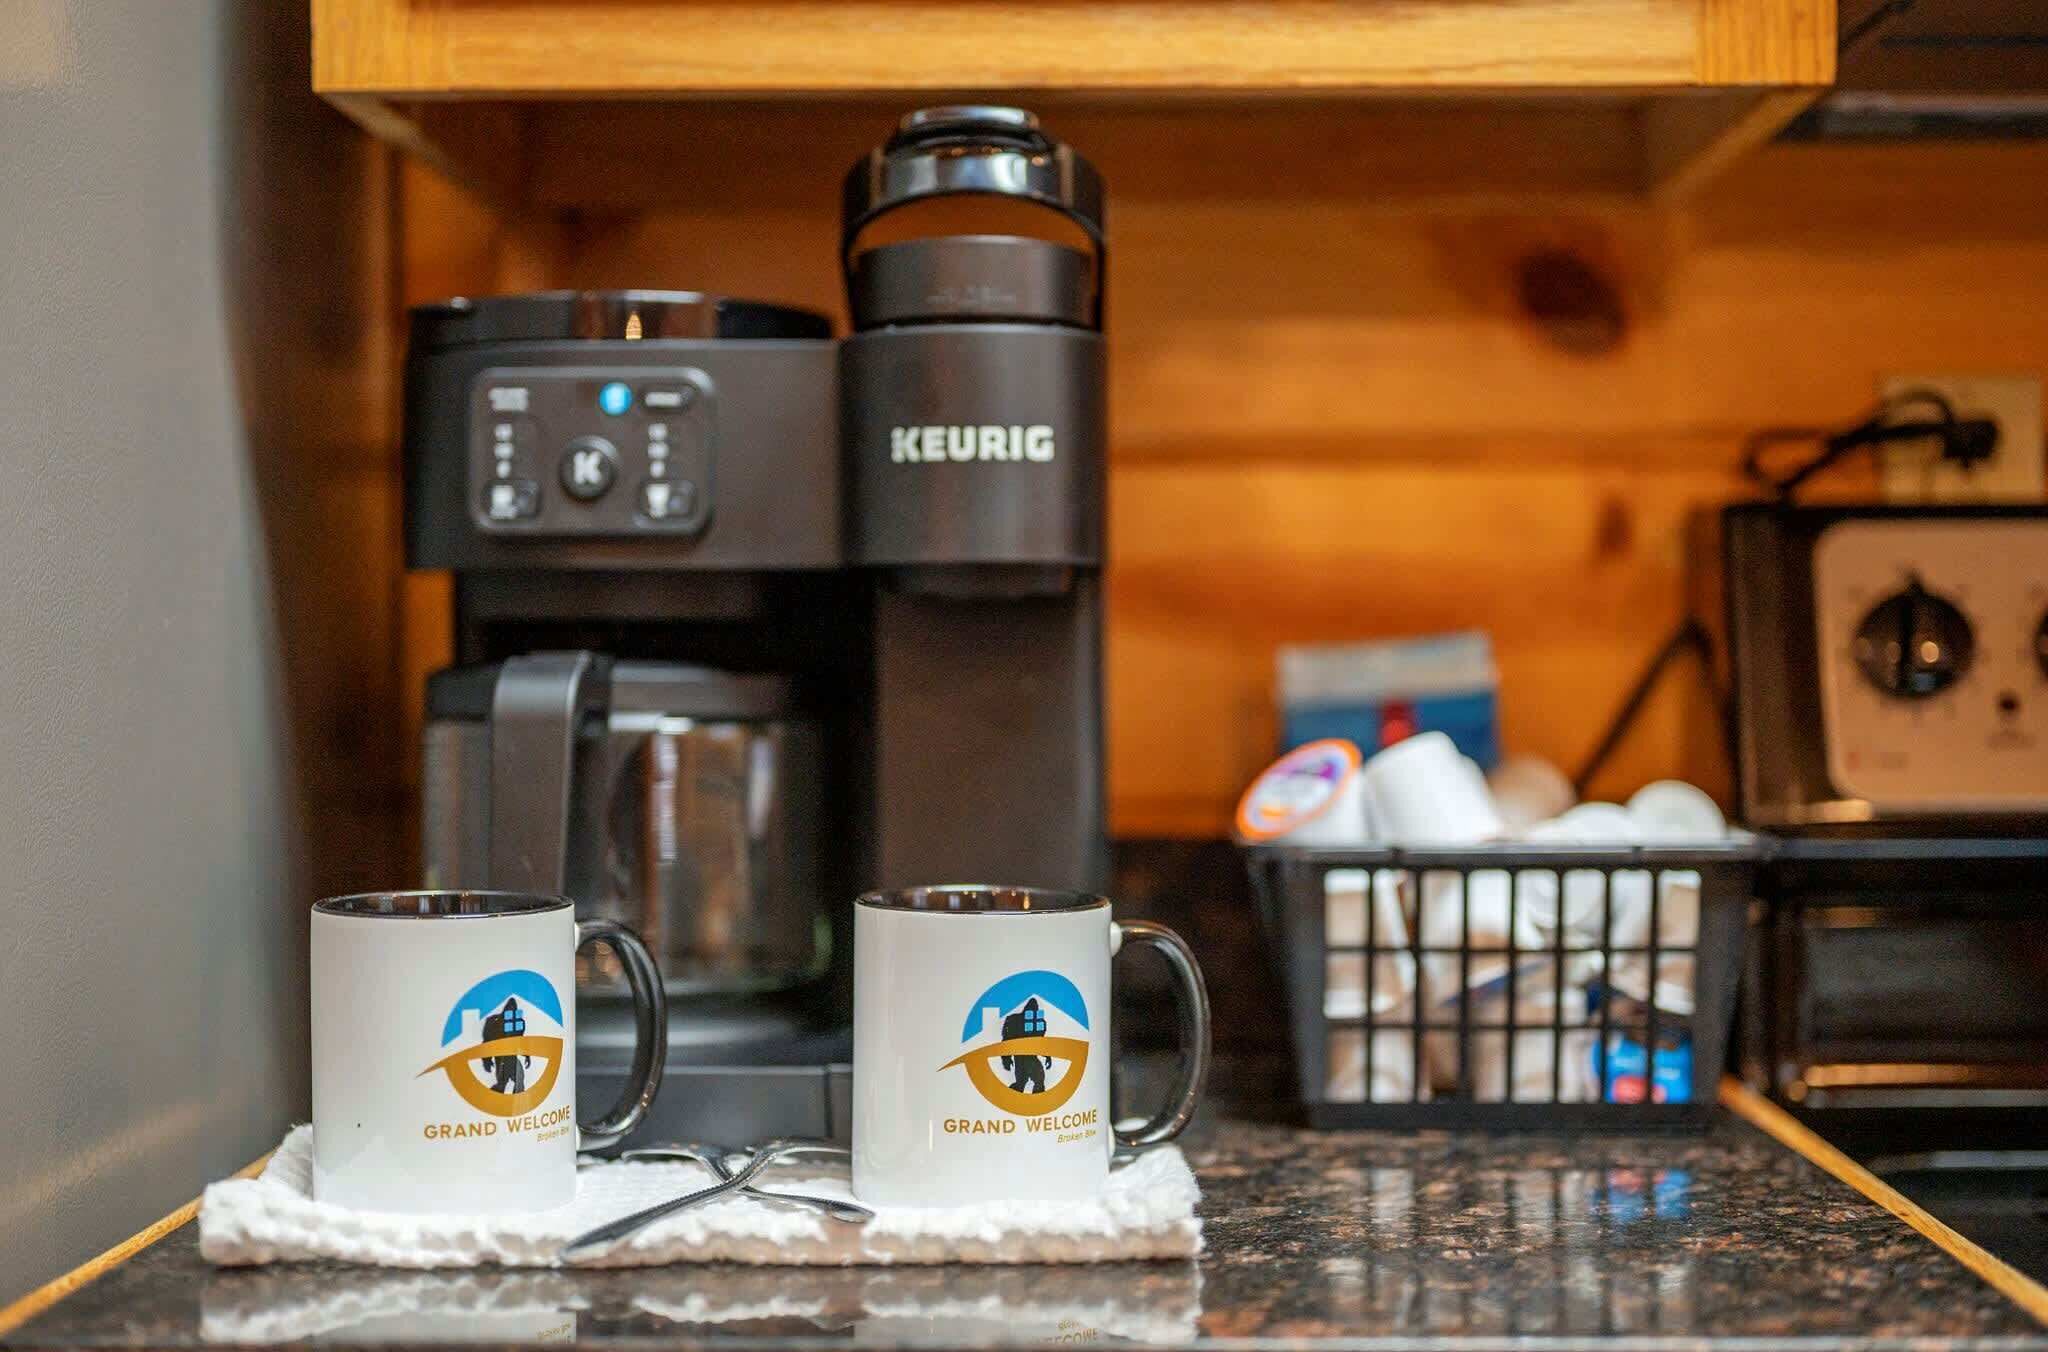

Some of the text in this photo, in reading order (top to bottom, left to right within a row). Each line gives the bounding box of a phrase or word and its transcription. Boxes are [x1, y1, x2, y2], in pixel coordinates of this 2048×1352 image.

[891, 425, 1055, 463] KEURIG
[573, 450, 602, 485] K
[423, 1105, 570, 1140] GRAND WELCOME
[943, 1109, 1097, 1134] GRAND WELCOME
